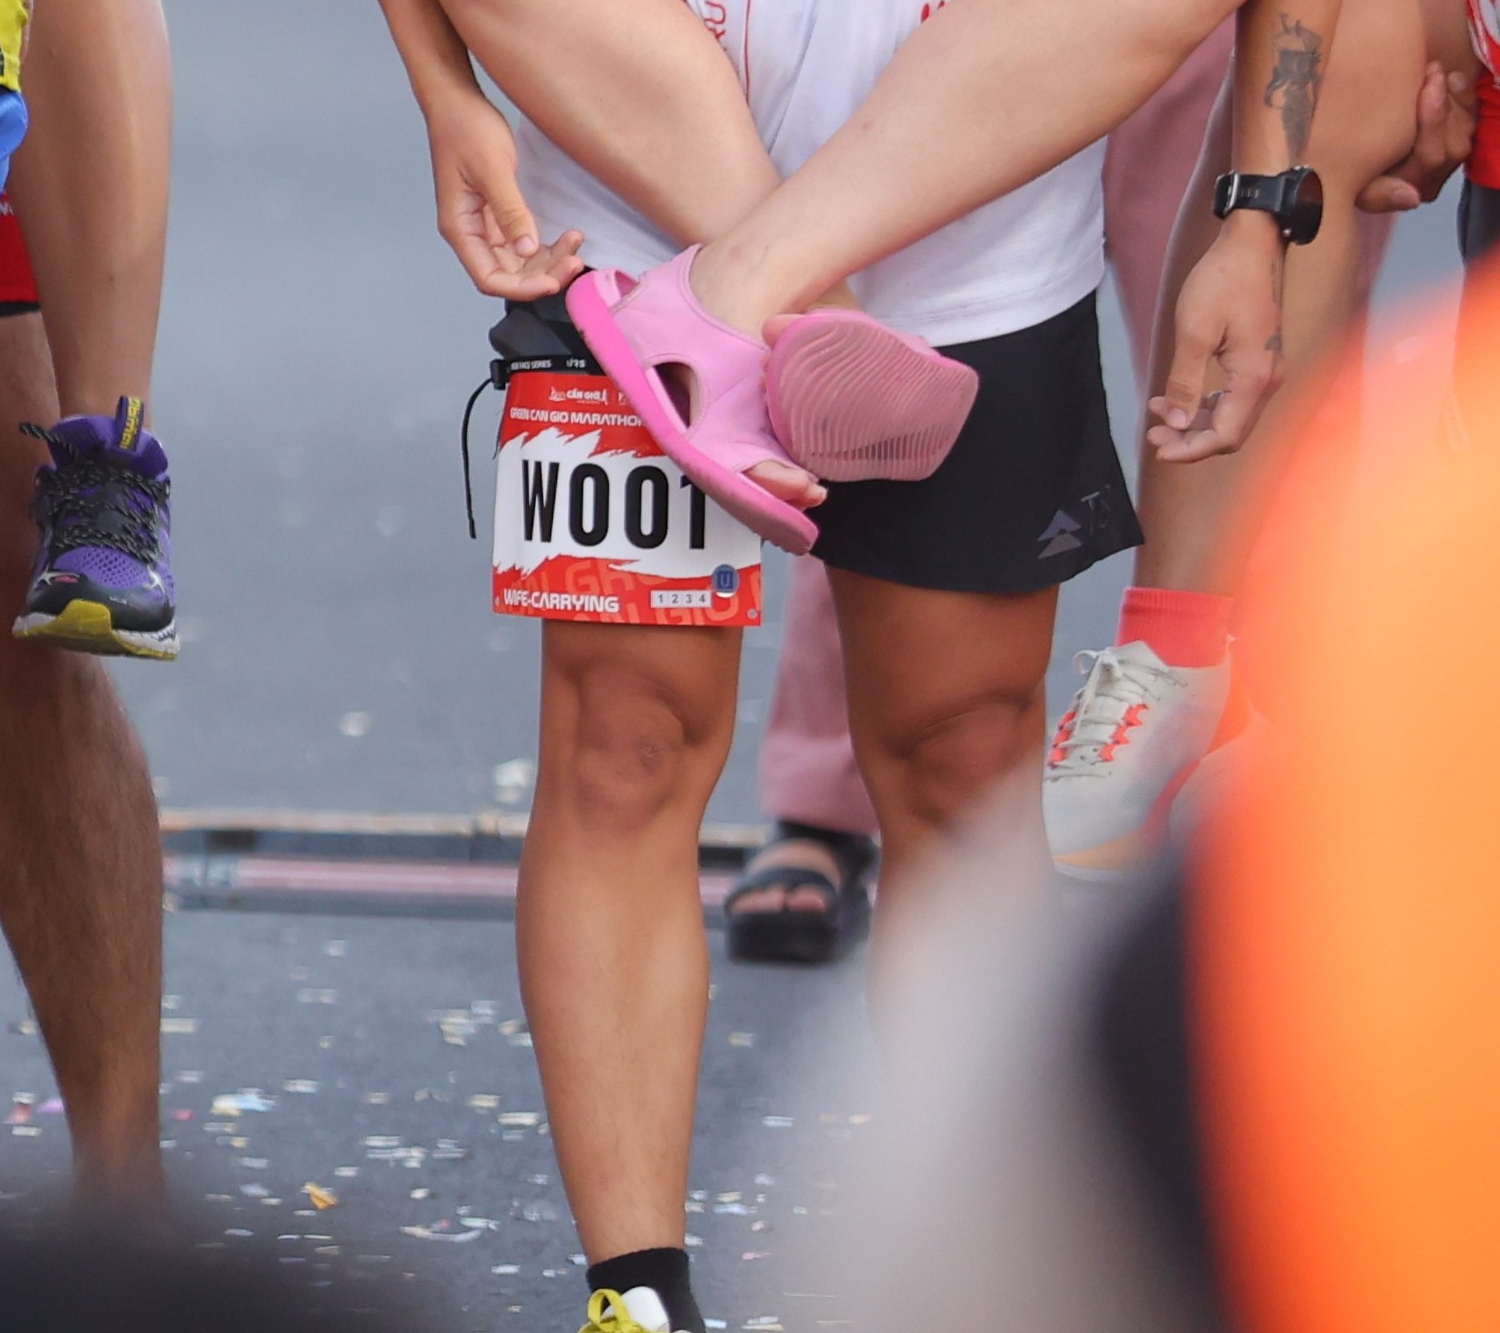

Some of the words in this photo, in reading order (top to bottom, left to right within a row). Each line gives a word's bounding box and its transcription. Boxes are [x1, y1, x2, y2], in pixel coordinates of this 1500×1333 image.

[510, 407, 529, 420] GREEN
[530, 408, 549, 421] CAN
[550, 411, 568, 423] GIO
[521, 459, 707, 550] W001
[504, 588, 620, 613] WIFE-CARRYING
